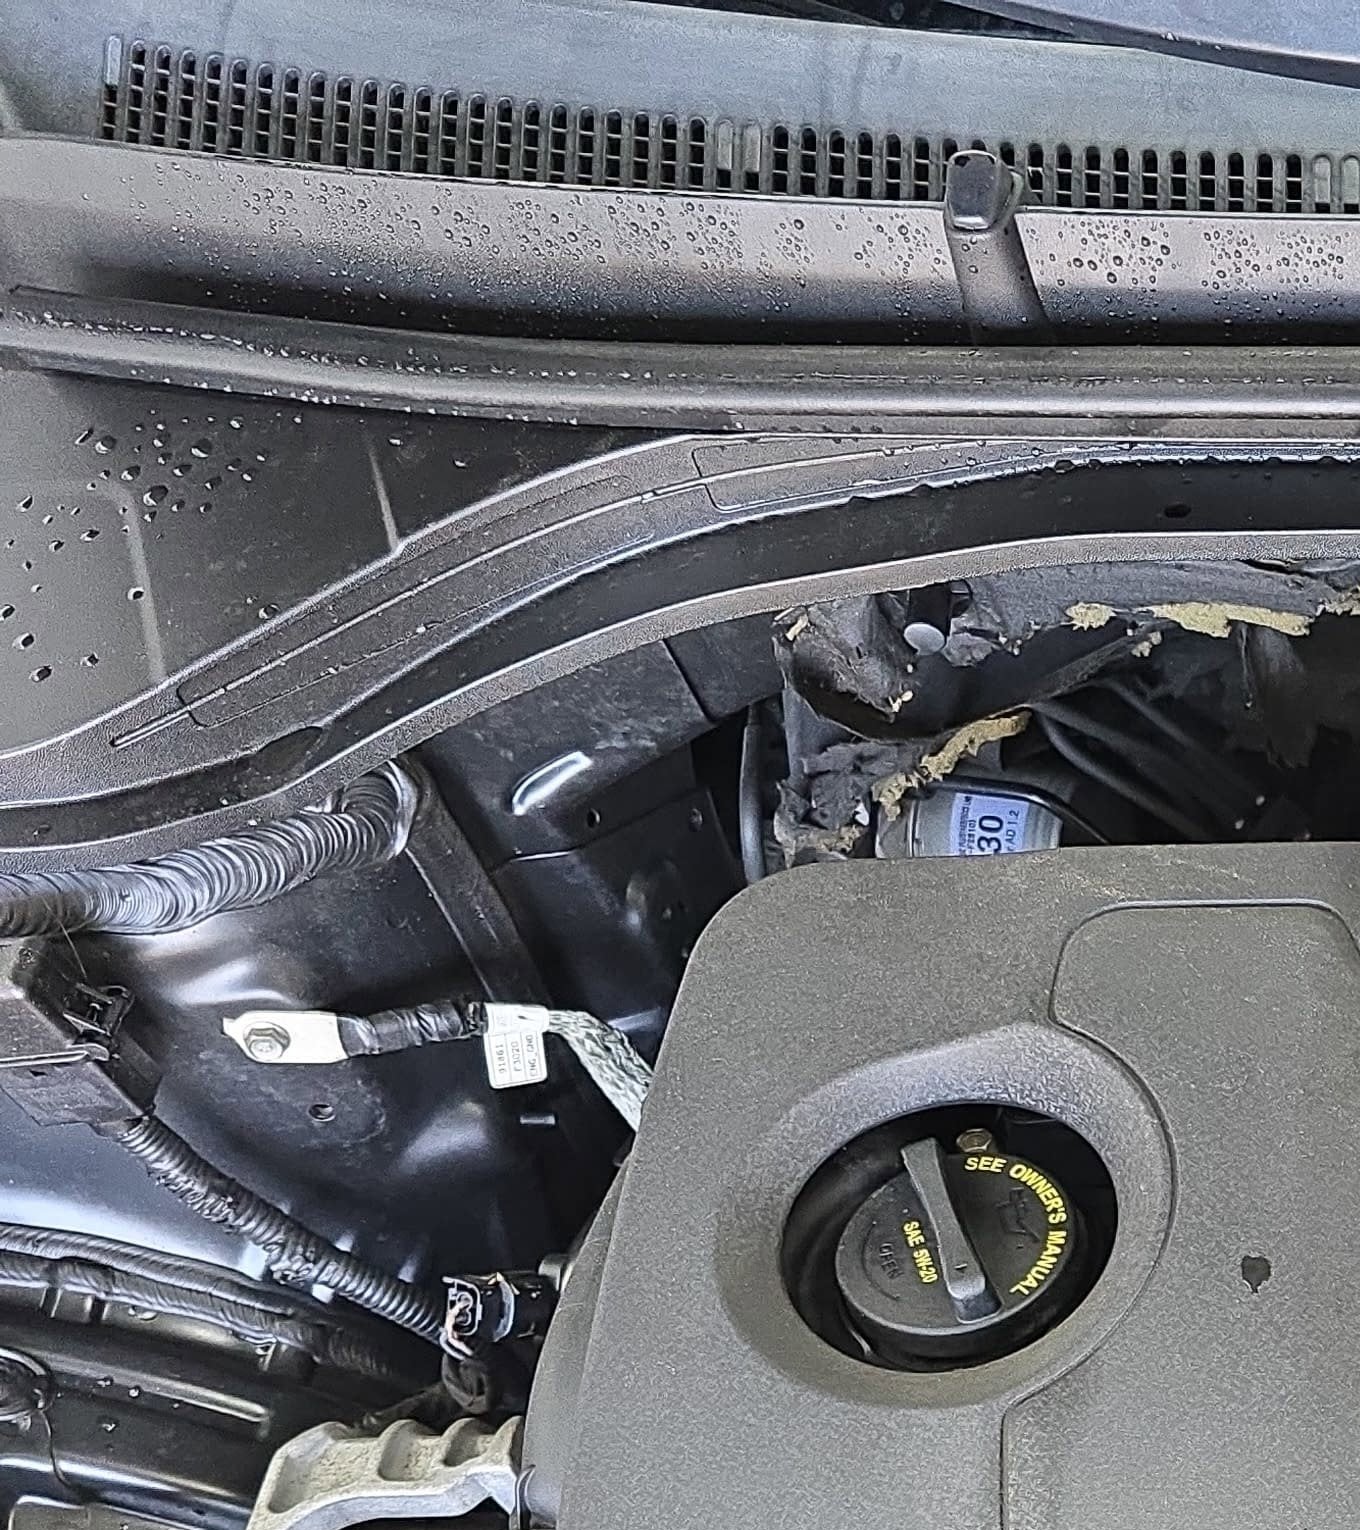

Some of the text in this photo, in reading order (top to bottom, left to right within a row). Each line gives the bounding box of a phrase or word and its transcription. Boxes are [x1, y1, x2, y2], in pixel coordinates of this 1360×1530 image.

[902, 1220, 939, 1284] SAE 5W-20
[963, 1154, 1068, 1297] SEE OWNER'S MANUAL
